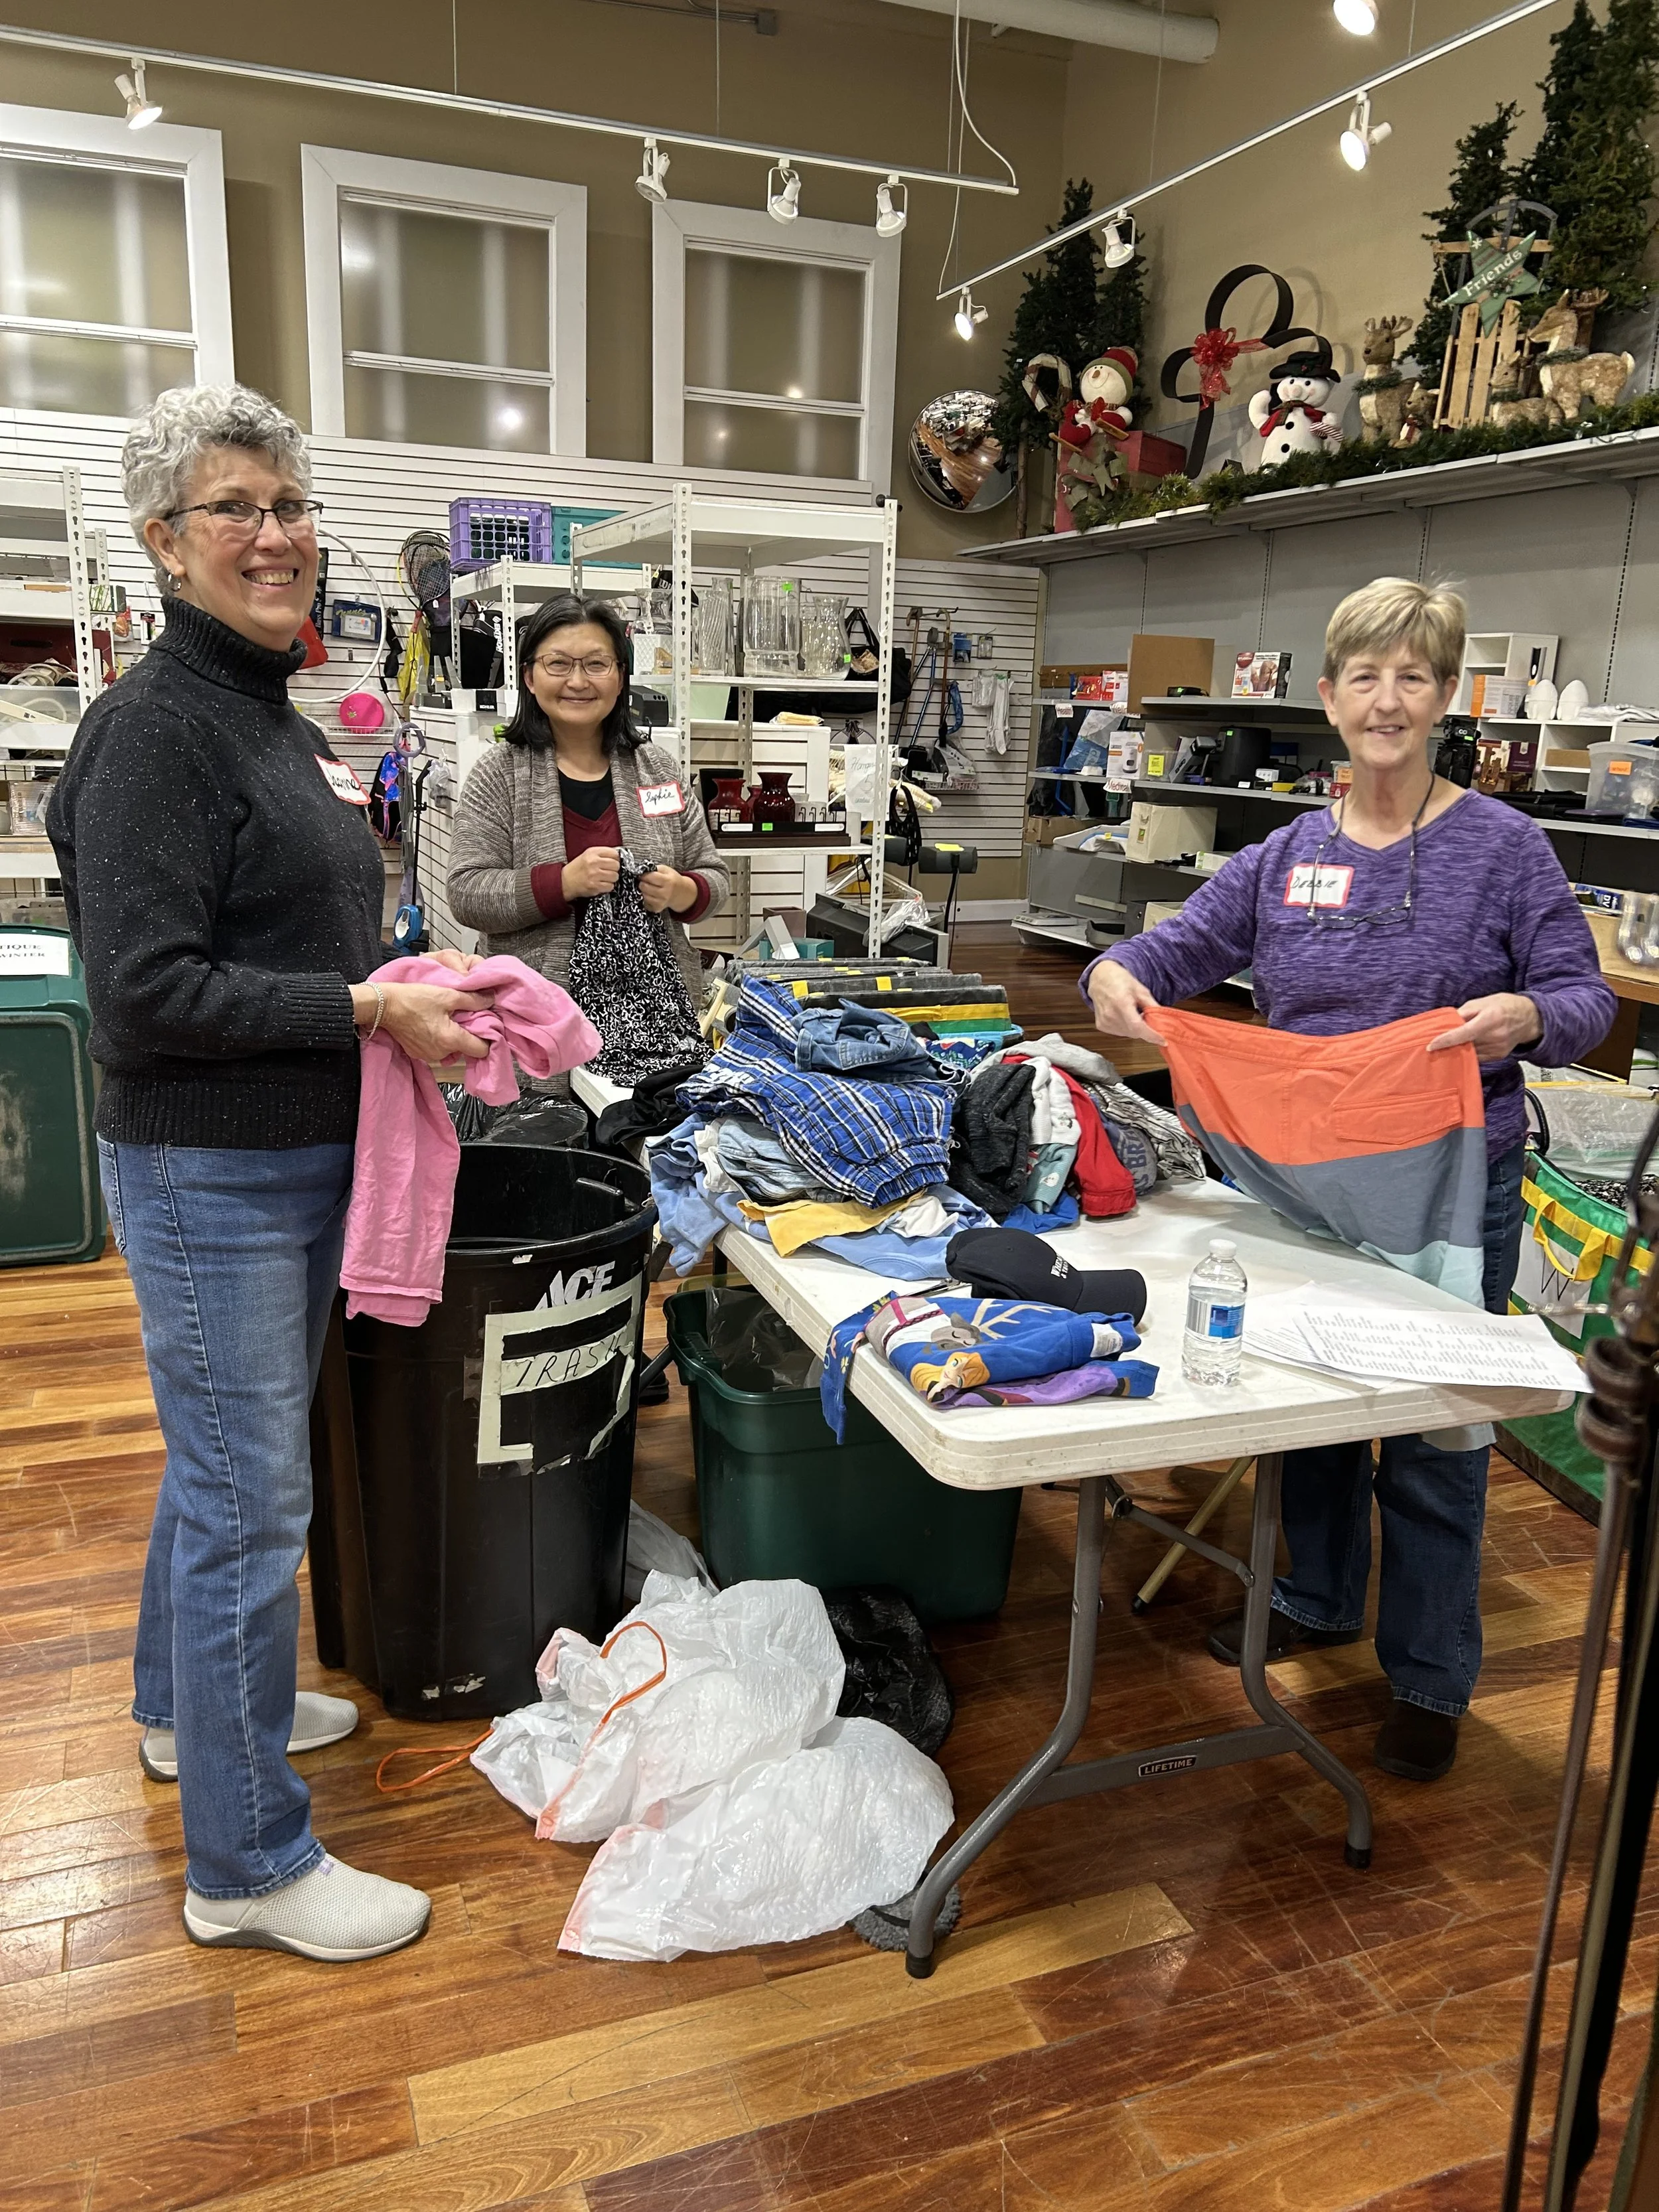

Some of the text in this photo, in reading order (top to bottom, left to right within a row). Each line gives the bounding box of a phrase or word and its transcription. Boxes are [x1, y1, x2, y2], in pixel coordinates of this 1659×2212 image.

[1462, 250, 1523, 297] Friends
[645, 788, 674, 805] Sophie
[1290, 876, 1338, 889] DEBBIE
[534, 1261, 616, 1311] ACE
[516, 1334, 624, 1387] TRASH
[1145, 1759, 1192, 1774] LIFETIME
